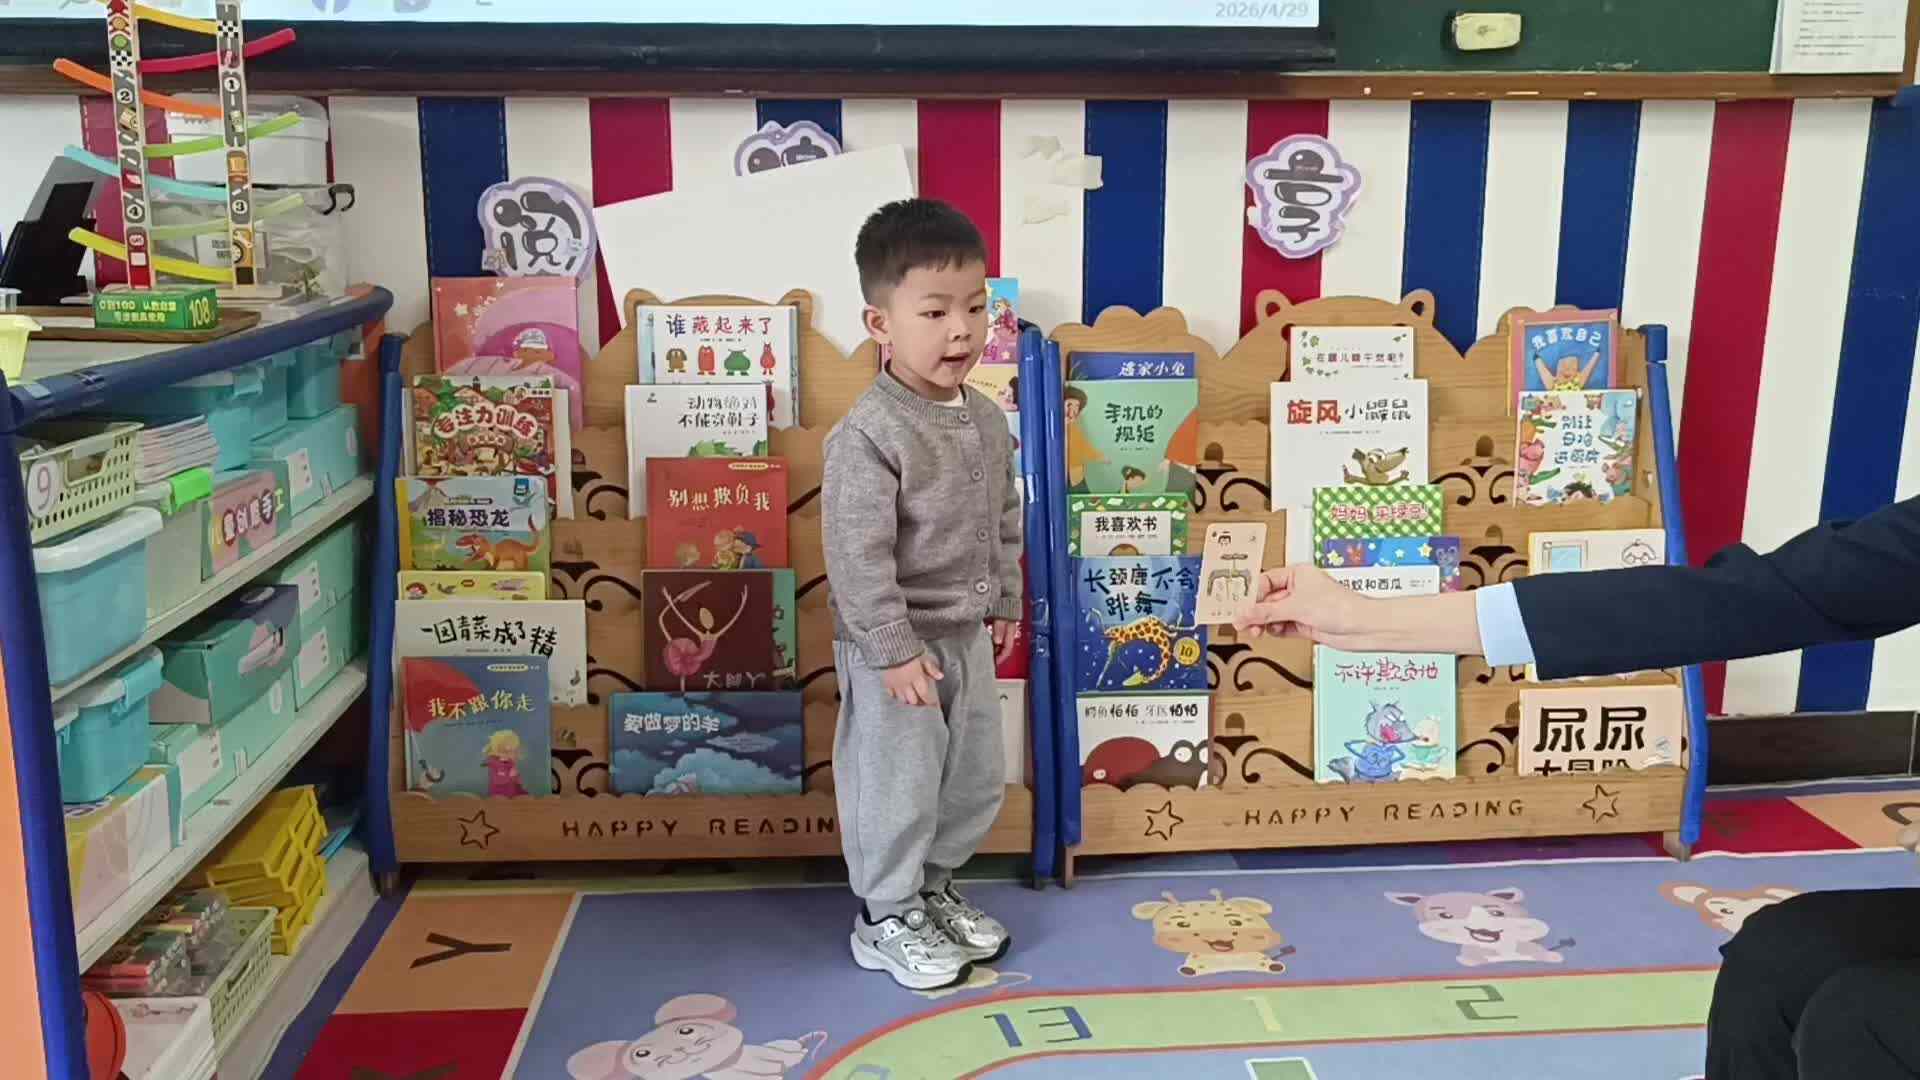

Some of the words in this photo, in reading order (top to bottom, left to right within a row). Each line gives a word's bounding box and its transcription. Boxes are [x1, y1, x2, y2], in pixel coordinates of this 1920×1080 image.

[1215, 4, 1308, 18] 2026/4/29
[120, 89, 131, 101] 2
[229, 79, 235, 90] 1
[236, 201, 246, 213] 3
[1263, 149, 1344, 244] 享
[130, 205, 140, 217] 4
[666, 313, 772, 338] 谁藏起来了
[437, 406, 535, 437] 专注力训练
[1105, 403, 1163, 423] 手机的
[1287, 399, 1411, 424] 旋风小鼹鼠
[1115, 425, 1154, 442] 规矩
[37, 466, 50, 510] 9
[668, 483, 770, 511] 别想欺负我
[427, 508, 510, 527] 揭秘恐龙
[1095, 516, 1157, 532] 我喜欢书
[1084, 563, 1194, 595] 长颈鹿不会
[1106, 591, 1167, 621] 跳舞
[1180, 645, 1194, 656] 10
[704, 672, 766, 688] 大脚丫
[427, 690, 536, 720] 我不跟你走
[1533, 706, 1647, 753] 尿尿
[1244, 805, 1356, 826] HAPPY
[1384, 799, 1525, 821] READING
[562, 819, 678, 838] HAPPY
[709, 817, 835, 834] READIN
[409, 932, 512, 969] Y
[1443, 984, 1519, 1022] 2
[982, 1004, 1093, 1049] 13
